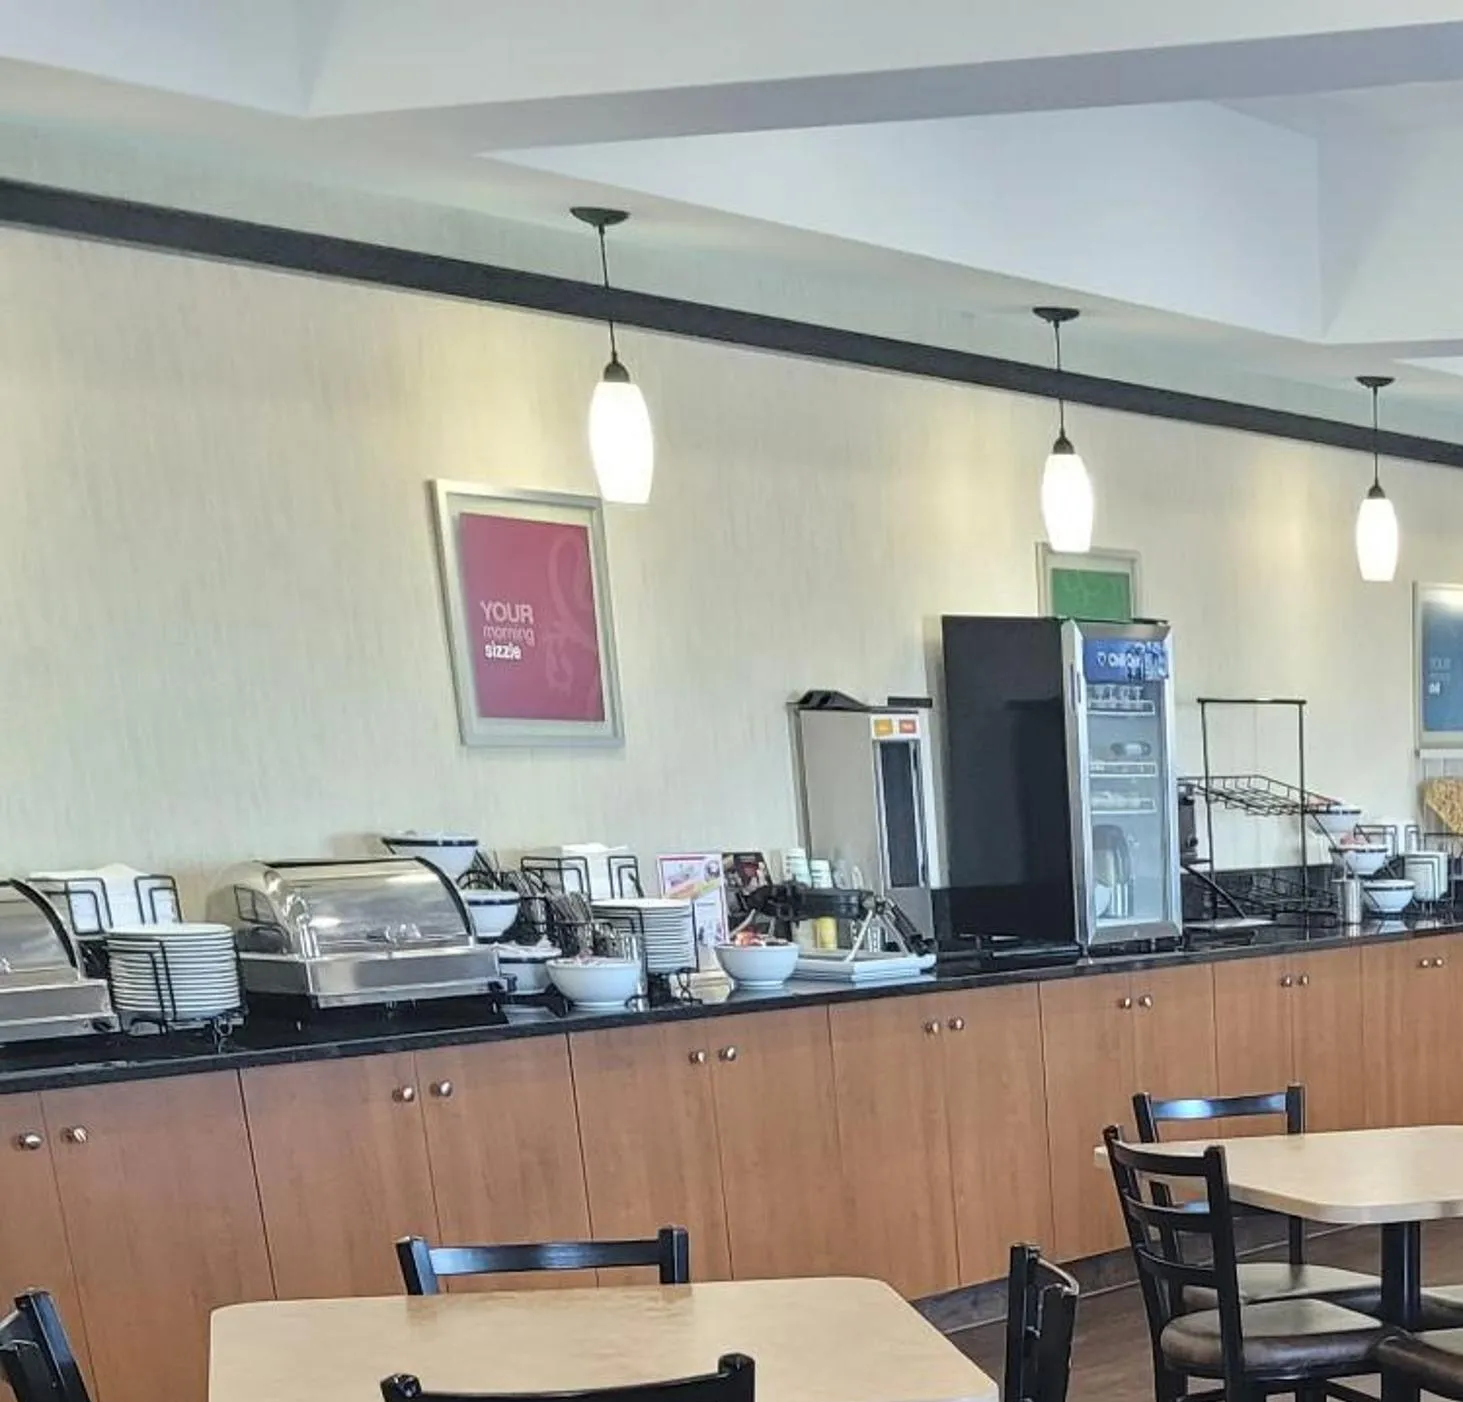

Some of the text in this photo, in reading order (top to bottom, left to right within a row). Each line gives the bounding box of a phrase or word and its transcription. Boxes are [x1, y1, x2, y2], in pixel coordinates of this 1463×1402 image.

[480, 600, 534, 624] YOUR
[483, 626, 535, 647] morning
[485, 641, 521, 660] sizzle
